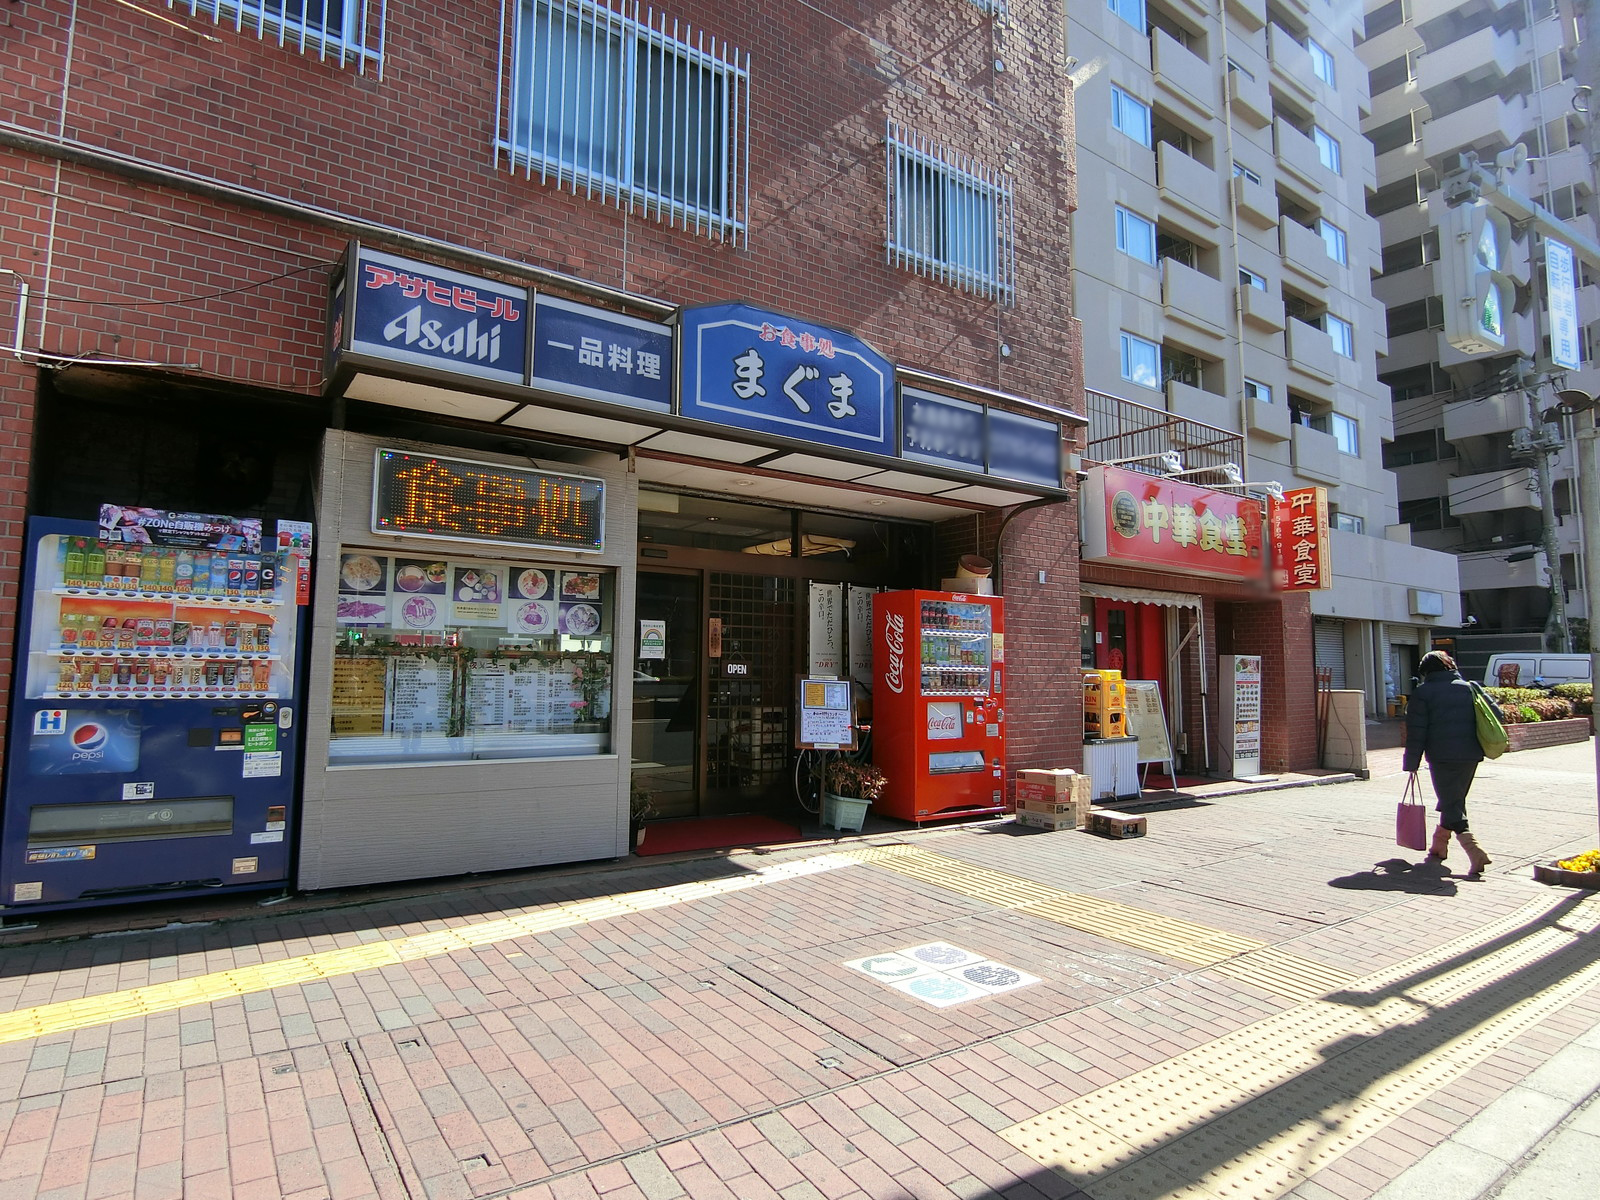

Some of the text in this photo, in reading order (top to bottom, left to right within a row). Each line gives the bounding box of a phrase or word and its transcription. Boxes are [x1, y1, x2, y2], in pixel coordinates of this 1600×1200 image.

[364, 264, 520, 322] アサヒビール
[383, 304, 501, 364] Asahi
[547, 336, 662, 381] 一品料理
[758, 321, 837, 360] お食事処
[731, 347, 858, 420] まぐま
[1141, 495, 1249, 558] 中華食堂
[1290, 491, 1318, 586] 中華食堂
[727, 663, 747, 675] OPEN
[885, 609, 904, 694] Coca-Cola
[927, 716, 957, 732] Coca-Cola
[72, 750, 104, 761] pepsi
